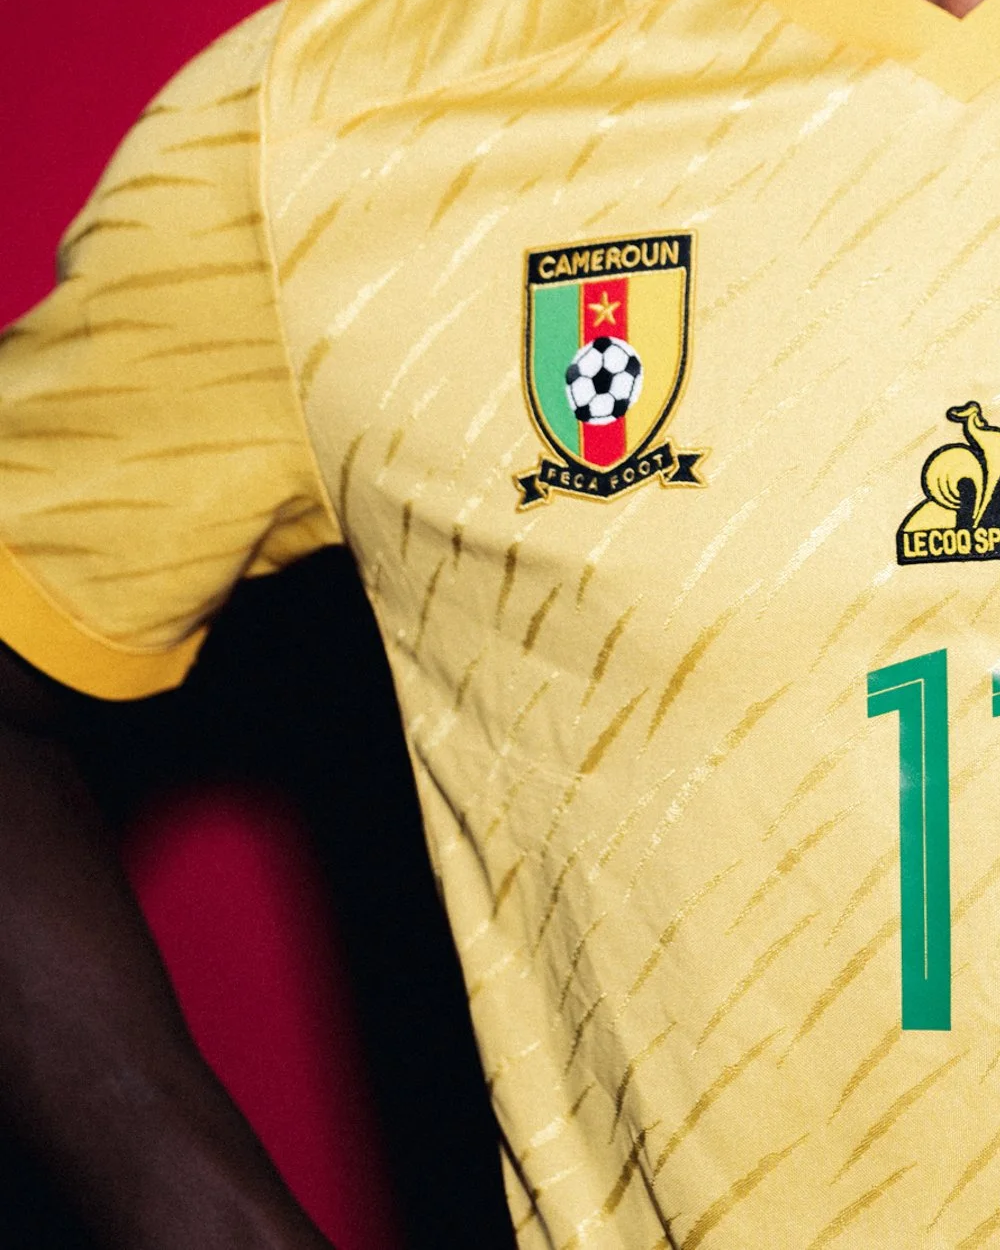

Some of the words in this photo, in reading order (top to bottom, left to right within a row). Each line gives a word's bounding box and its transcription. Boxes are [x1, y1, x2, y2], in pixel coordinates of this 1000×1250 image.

[538, 241, 680, 279] CAMEROUN
[610, 454, 664, 490] FOOT
[903, 530, 928, 558] LE
[928, 528, 971, 556] COQ
